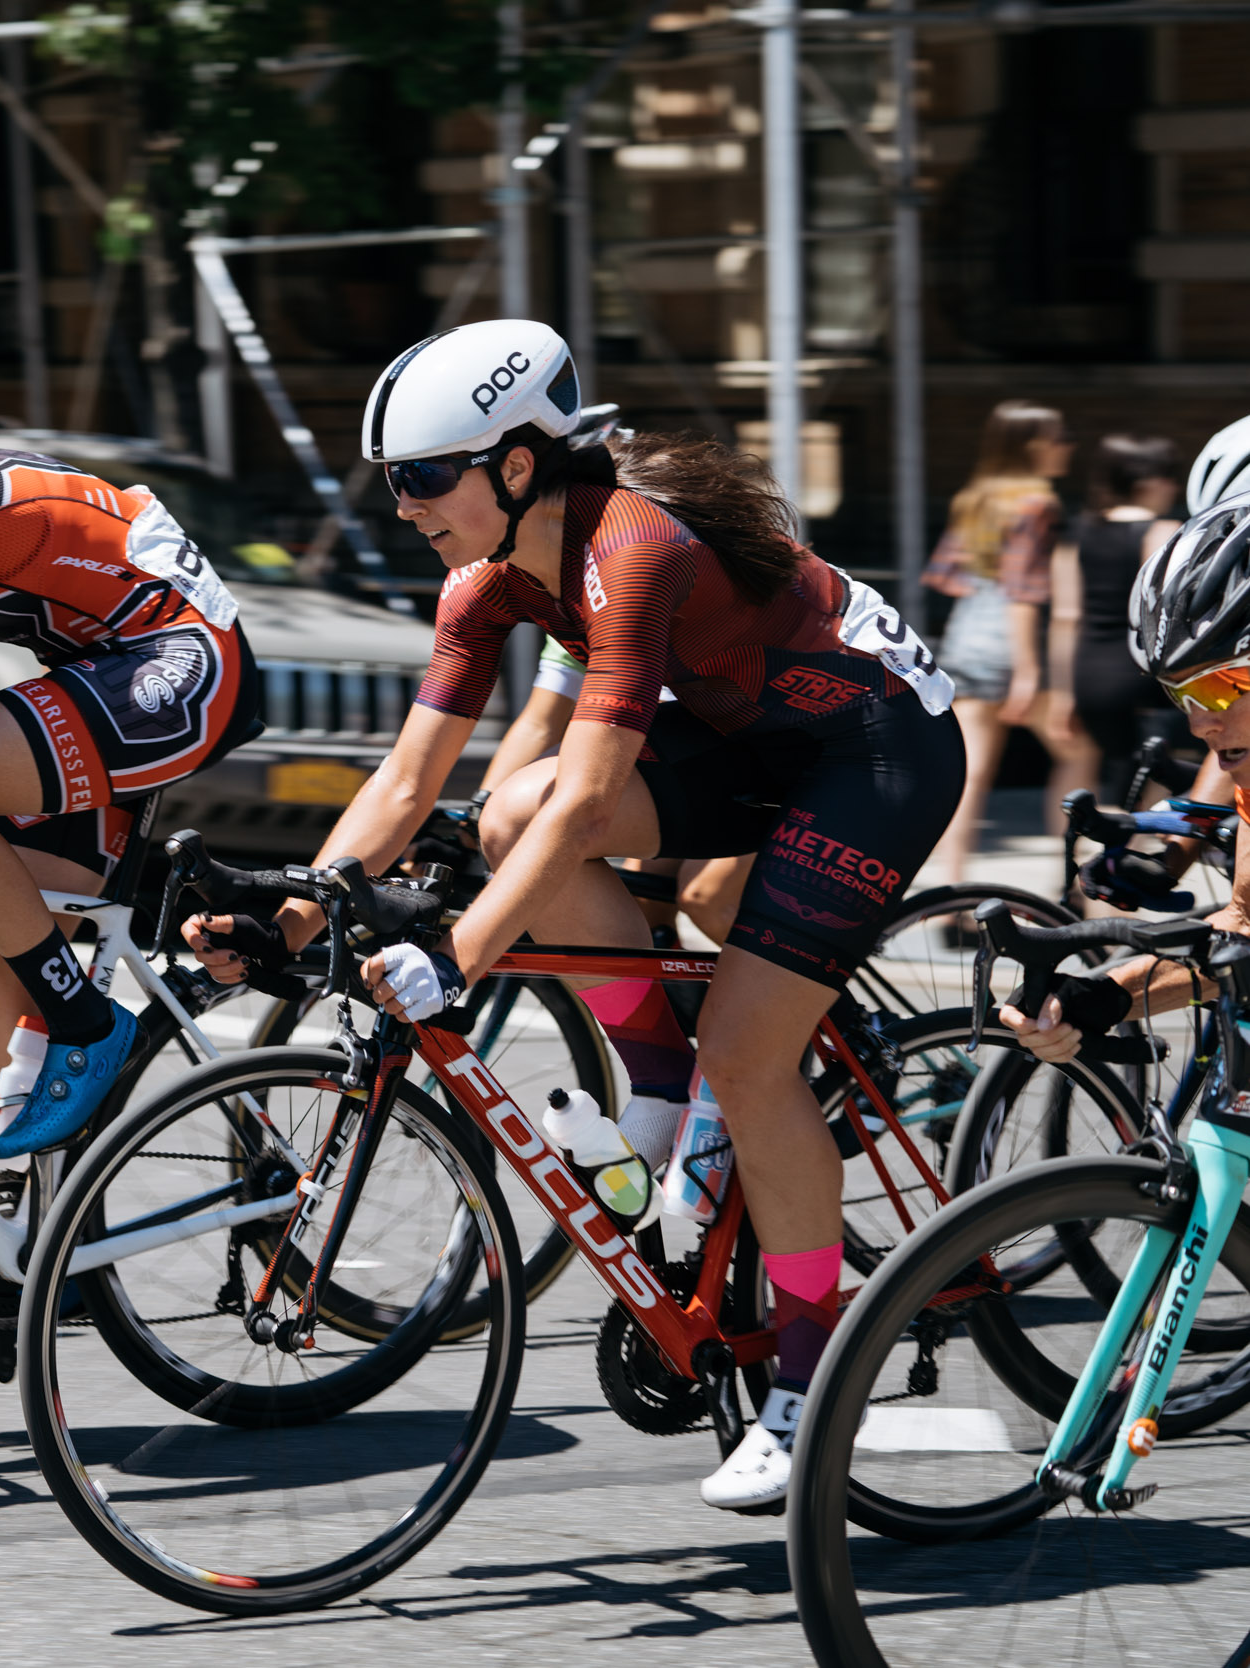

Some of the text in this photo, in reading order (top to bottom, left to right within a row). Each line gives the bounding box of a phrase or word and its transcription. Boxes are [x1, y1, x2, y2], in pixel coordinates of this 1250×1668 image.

[52, 556, 126, 578] PARLEE
[18, 681, 84, 771] FEARLESS
[786, 807, 817, 825] THE
[771, 821, 902, 895] METEOR
[772, 845, 887, 908] INTELLIGENTSIA
[444, 1052, 667, 1309] FOCUS
[1149, 1222, 1209, 1375] Bianchi
